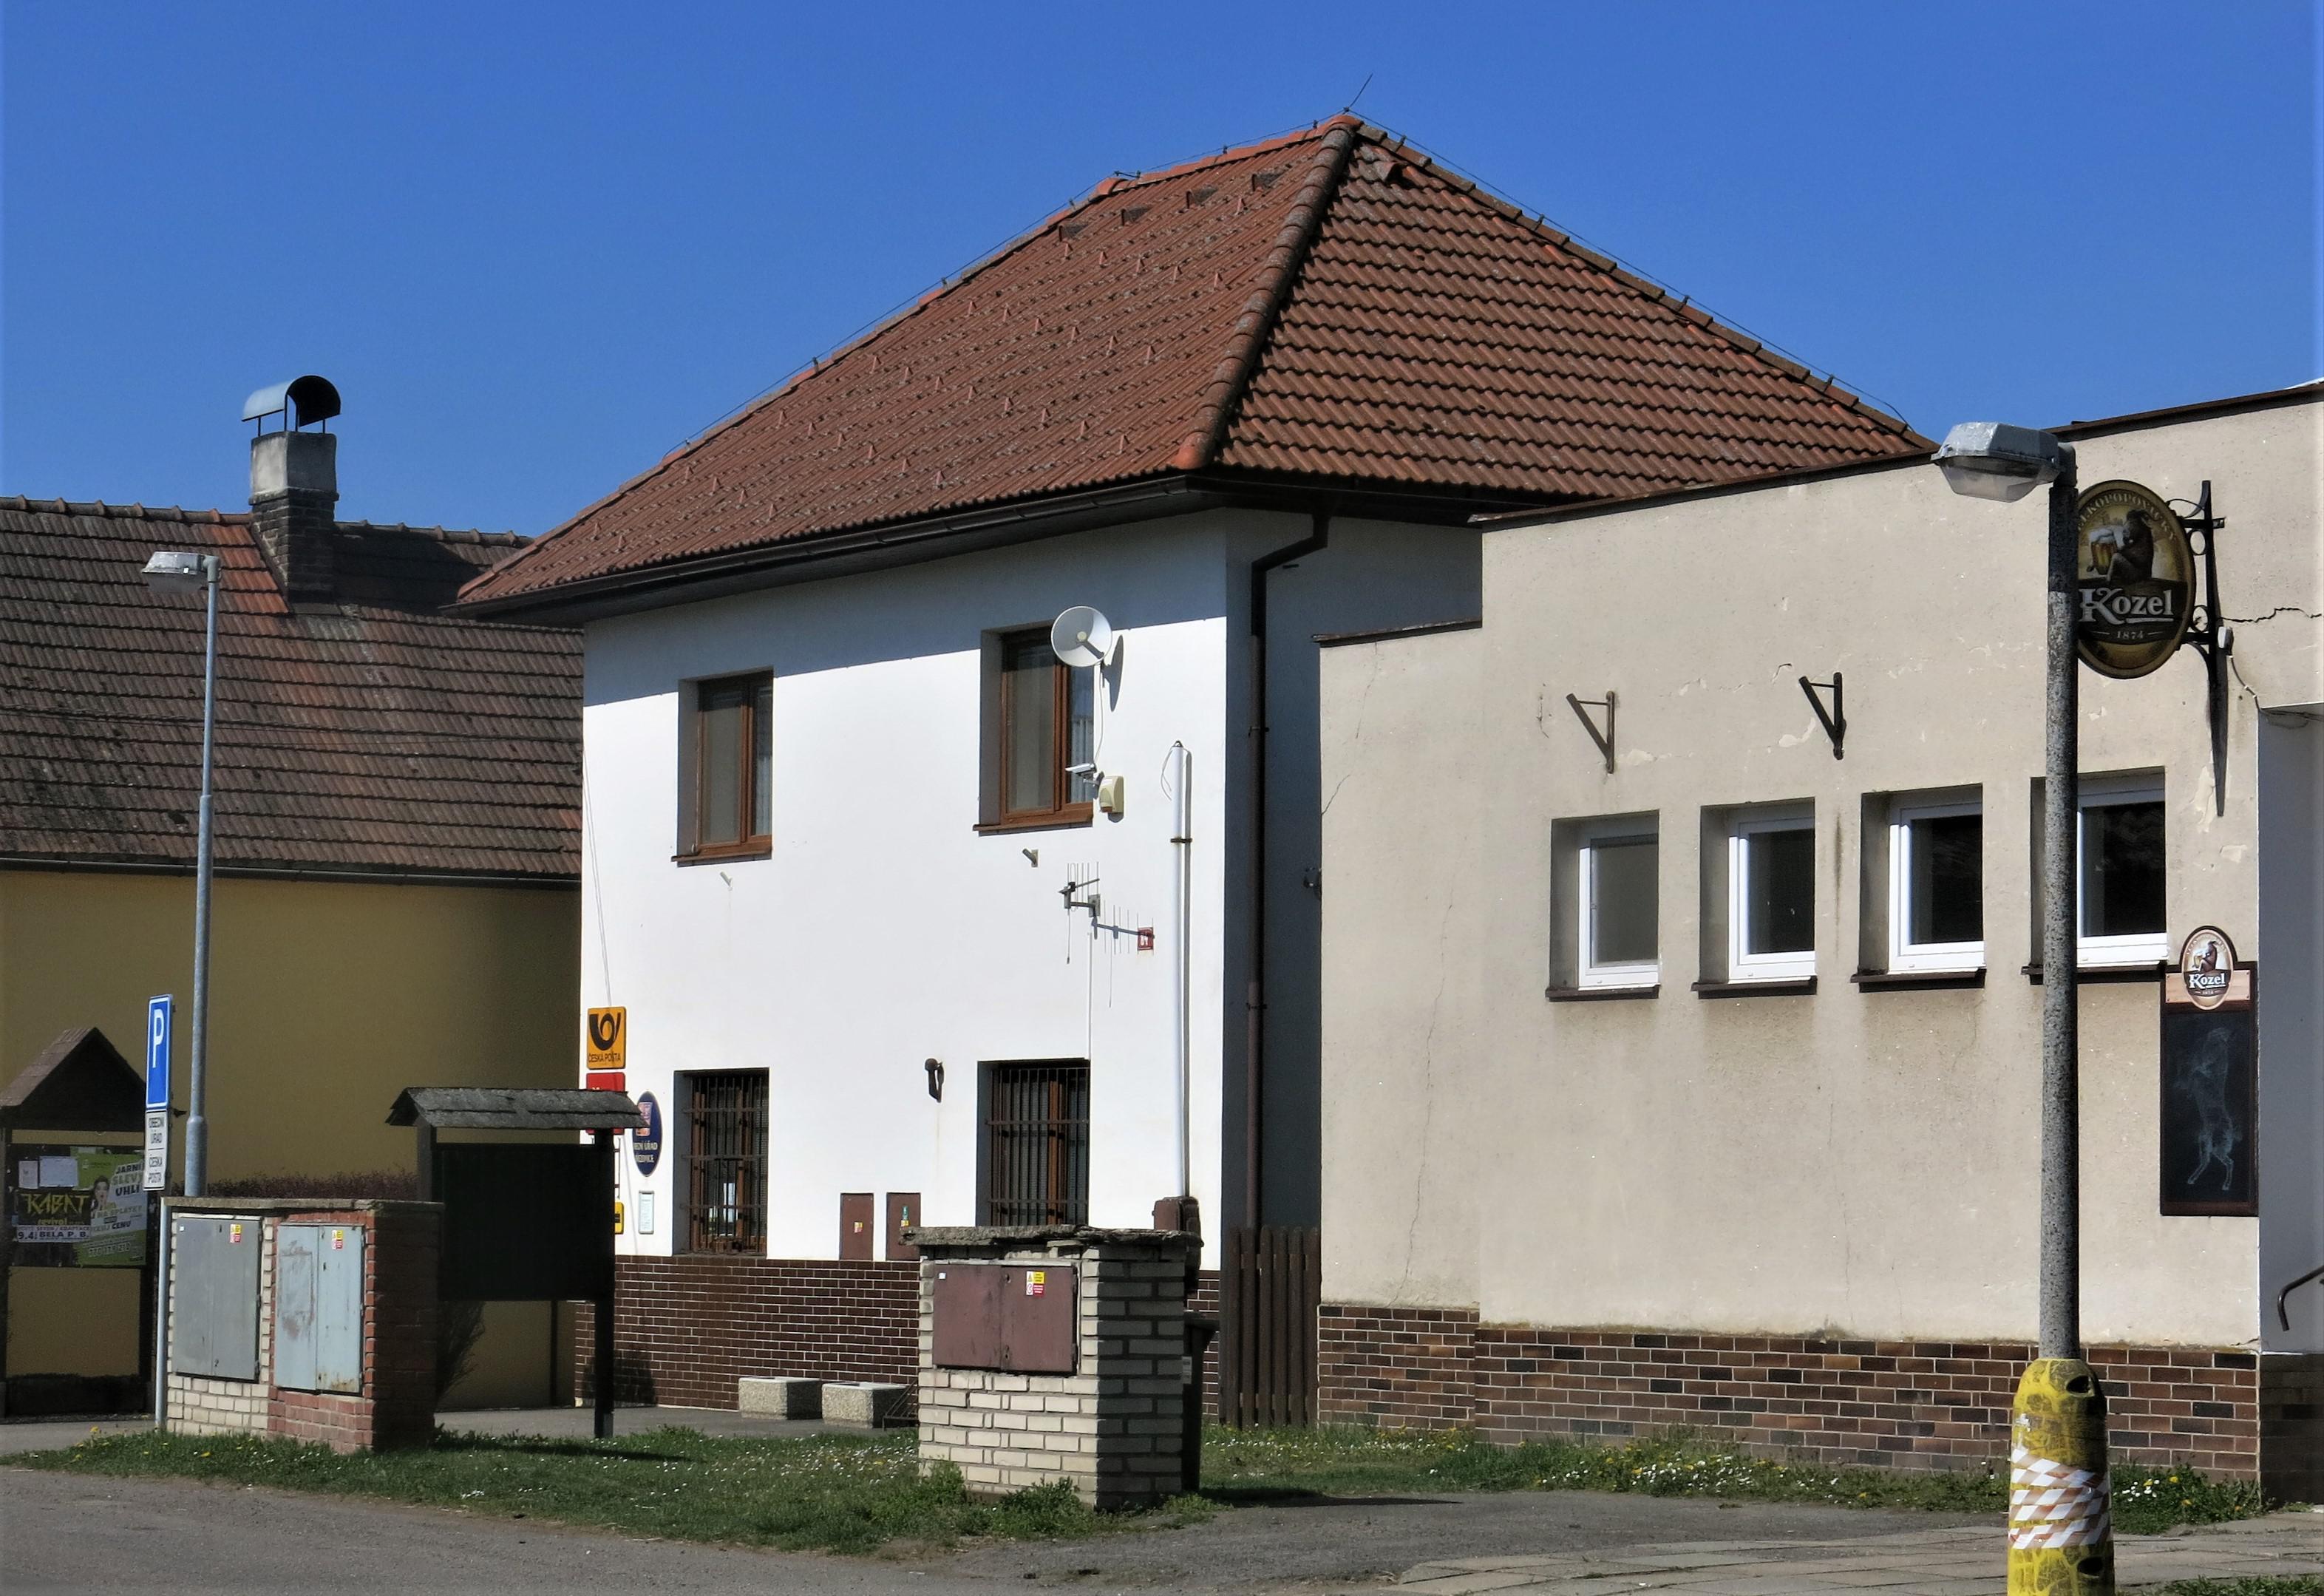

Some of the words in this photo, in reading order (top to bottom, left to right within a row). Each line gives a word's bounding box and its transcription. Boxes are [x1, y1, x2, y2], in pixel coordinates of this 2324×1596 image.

[2079, 588, 2174, 625] Kozel
[2116, 631, 2144, 639] 1874
[2189, 973, 2226, 989] Kozel
[152, 1008, 165, 1068] P
